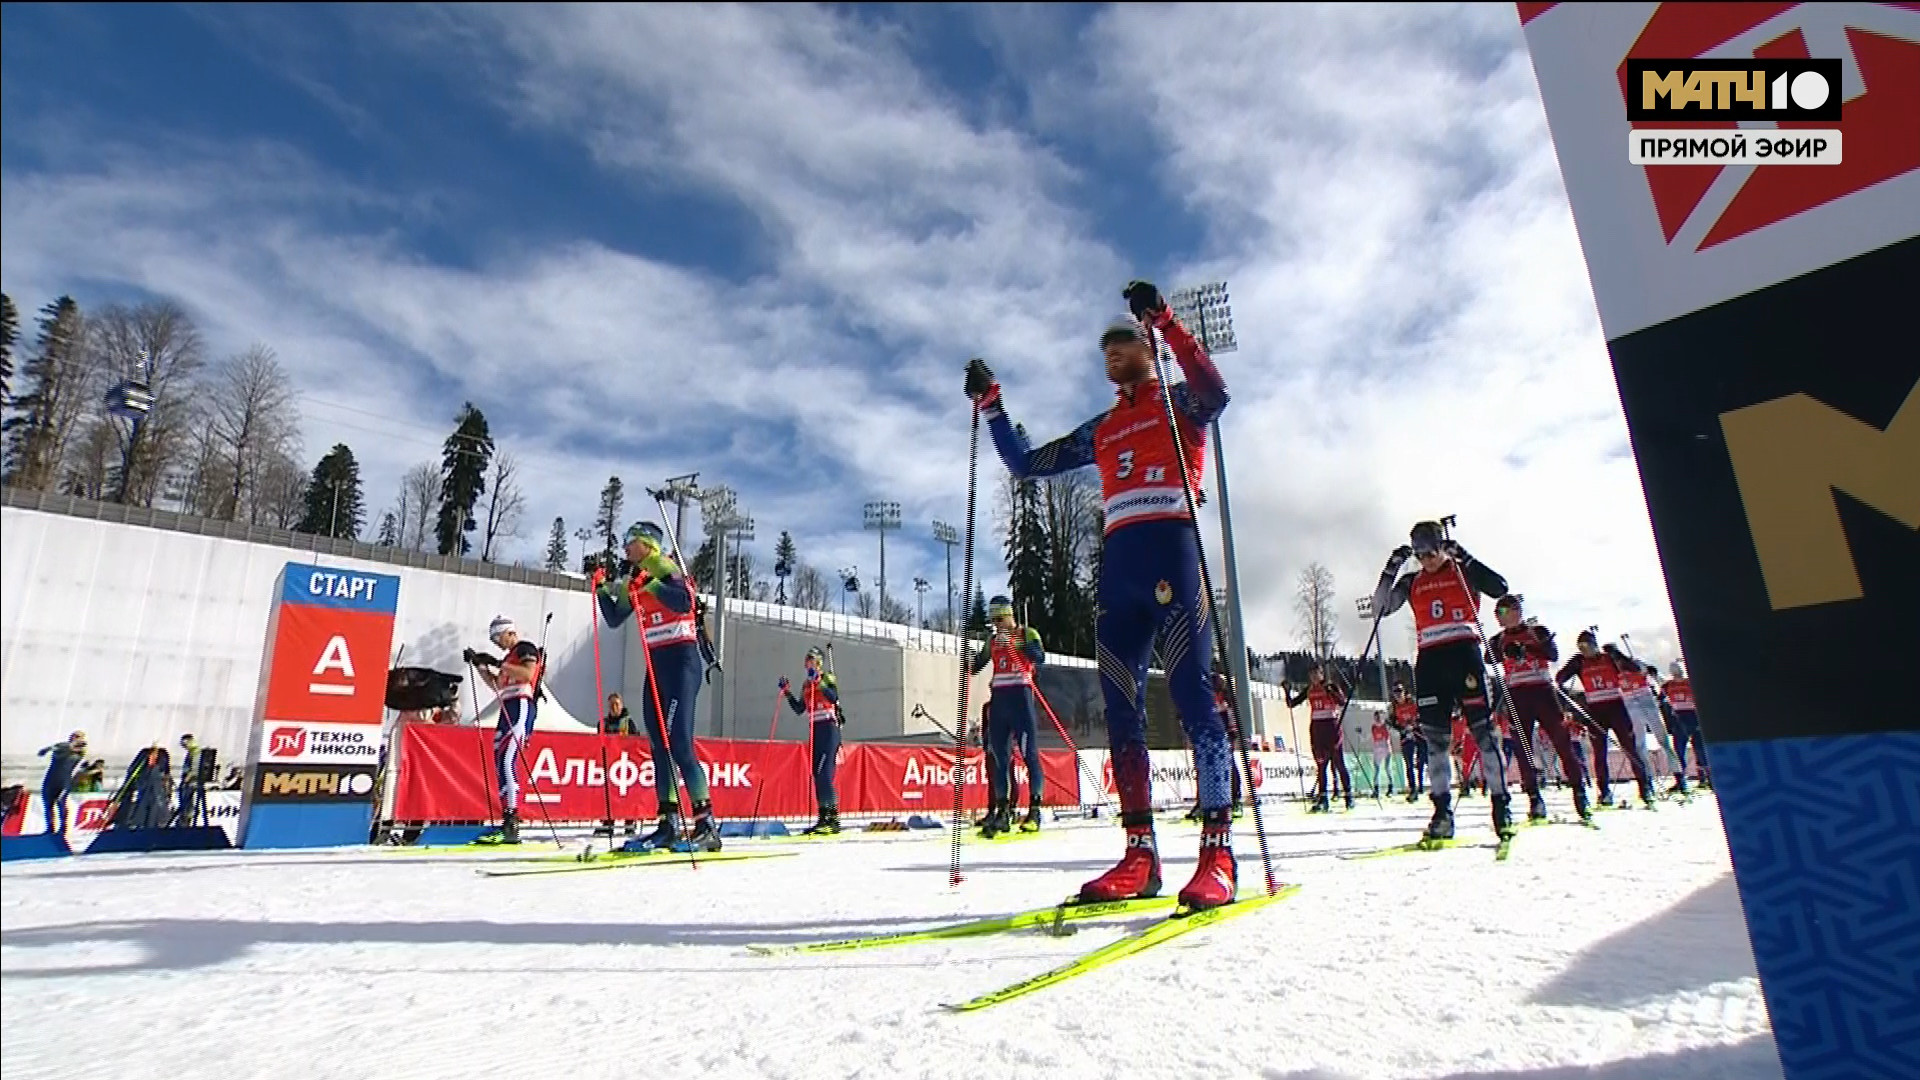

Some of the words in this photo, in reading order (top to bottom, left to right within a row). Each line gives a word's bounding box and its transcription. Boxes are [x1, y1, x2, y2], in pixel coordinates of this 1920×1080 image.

[1116, 449, 1135, 480] 3
[309, 572, 378, 602] СТАРТ
[1431, 599, 1445, 619] 6
[311, 731, 364, 743] ТЕХНО
[311, 744, 377, 755] НИКОЛЬ
[1075, 902, 1129, 915] FISCHER
